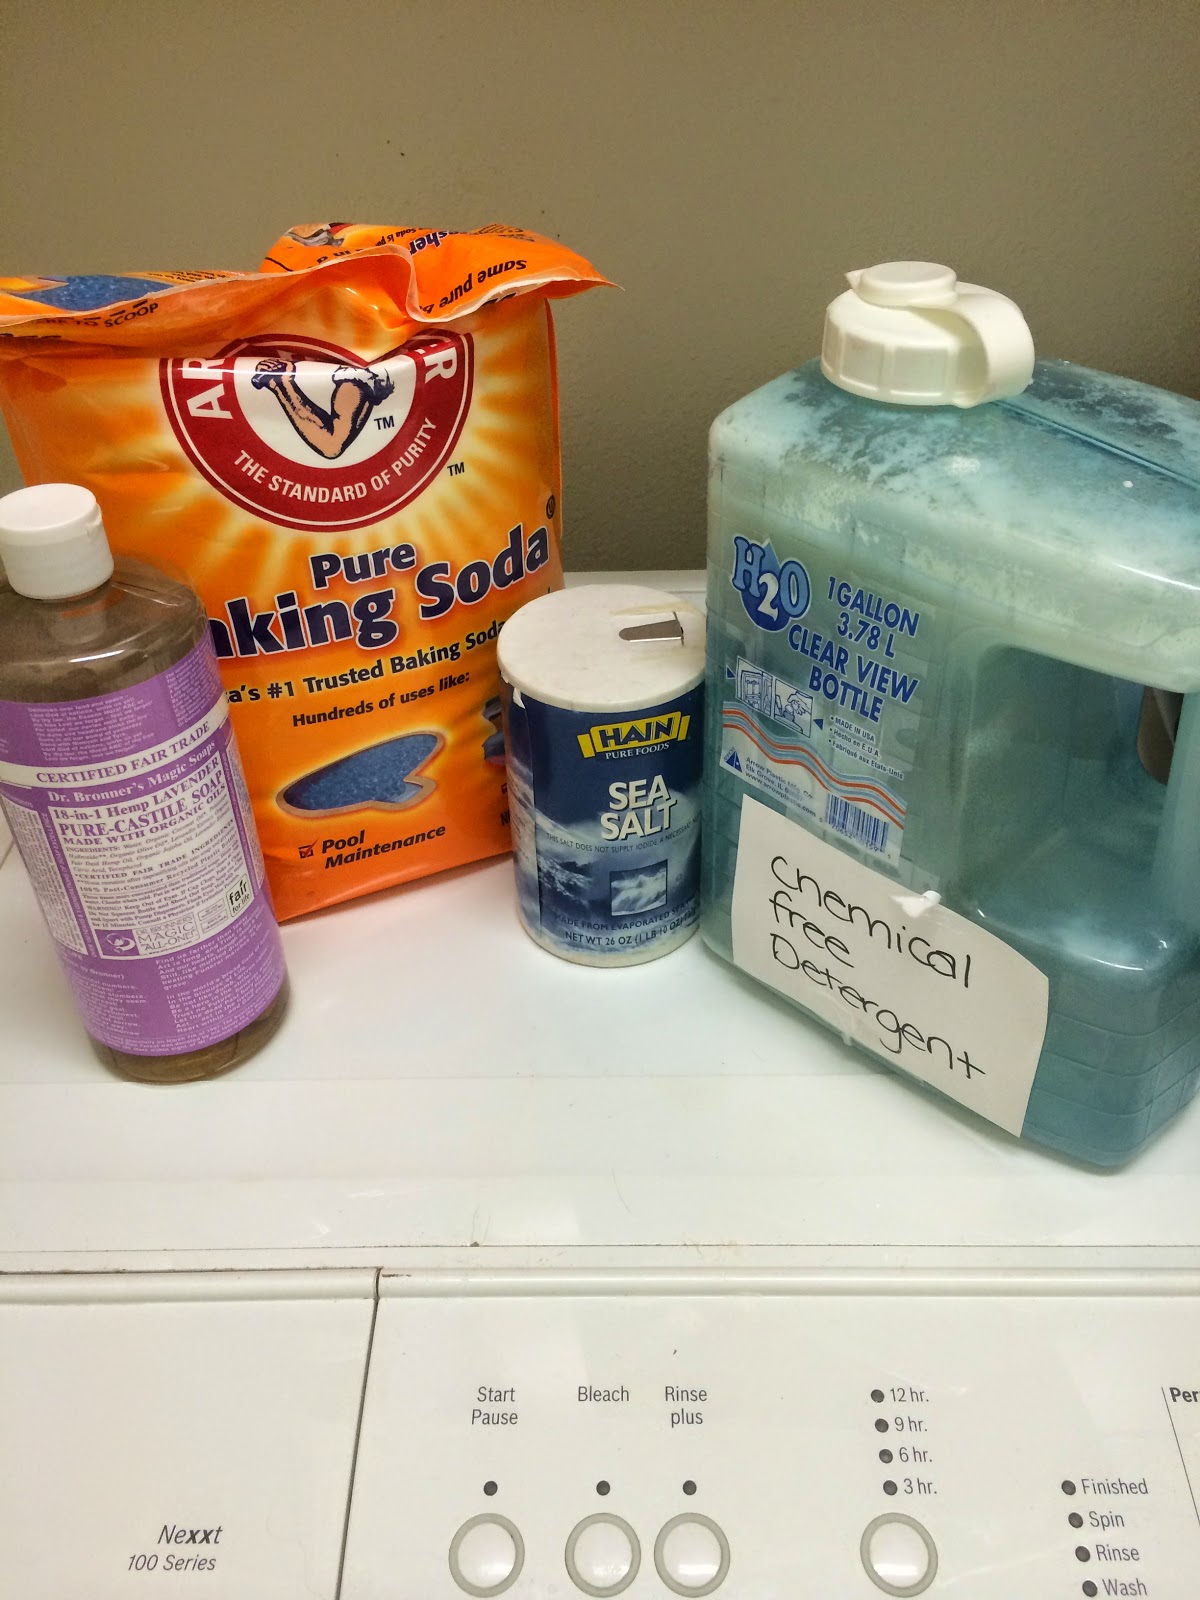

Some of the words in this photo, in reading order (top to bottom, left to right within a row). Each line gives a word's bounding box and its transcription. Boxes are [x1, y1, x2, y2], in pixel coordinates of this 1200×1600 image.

[477, 260, 528, 283] Same
[439, 277, 473, 309] pure
[104, 302, 159, 327] SCOOP
[182, 357, 233, 420] AR
[374, 416, 395, 431] TM
[233, 450, 264, 485] THE
[268, 475, 369, 504] STANDARD
[371, 472, 392, 491] OF
[392, 417, 438, 478] PURITY
[447, 462, 466, 477] TM
[310, 542, 417, 590] Pure
[415, 523, 550, 621] Soda
[837, 582, 920, 637] GALLON
[837, 611, 882, 651] 3.78
[885, 633, 896, 659] L
[267, 682, 294, 699] #1
[303, 660, 385, 695] Trusted
[390, 640, 461, 674] Baking
[788, 624, 850, 676] CLEAR
[857, 655, 920, 705] VIEW
[293, 700, 375, 728] Hundreds
[379, 694, 397, 711] of
[400, 686, 435, 706] uses
[438, 670, 471, 694] like:
[808, 665, 884, 723] BOTTLE
[598, 716, 676, 748] HAIN
[833, 729, 852, 743] Hecho
[835, 717, 853, 731] MADE
[854, 726, 861, 734] IN
[862, 731, 875, 743] USA
[36, 763, 128, 784] CERTIFIED
[130, 749, 168, 771] FAIR
[169, 720, 210, 755] TRADE
[605, 749, 634, 761] PURE
[635, 741, 671, 757] FOODS
[48, 791, 70, 803] Dr.
[73, 781, 145, 803] Bronner's
[147, 762, 187, 788] Magic
[188, 740, 216, 767] Soaps
[746, 757, 766, 771] Arrow
[858, 755, 870, 765] aux
[871, 760, 904, 780] Etats-Unis
[52, 807, 102, 821] 18-in-1
[106, 802, 150, 819] Hemp
[152, 756, 220, 806] LAVENDER
[608, 774, 671, 812] SEA
[59, 798, 189, 838] PURE-CASTILE
[191, 769, 223, 805] SOAP
[63, 837, 102, 846] MADE
[107, 829, 146, 844] WITH
[149, 804, 204, 834] ORGANIC
[206, 784, 226, 804] OILS
[600, 799, 677, 841] SALT
[321, 830, 366, 854] Pool
[324, 825, 447, 869] Maintenance
[546, 833, 559, 844] THIS
[560, 839, 574, 849] SALT
[575, 843, 593, 852] DOES
[611, 844, 634, 854] SUPPLY
[635, 839, 658, 851] IODIDE
[659, 835, 664, 844] A
[229, 880, 248, 907] fair
[138, 922, 195, 943] MAGIC
[581, 920, 608, 930] FROM
[611, 912, 670, 931] EVAPORATED
[565, 931, 584, 943] NET
[586, 937, 602, 946] WT
[605, 937, 615, 946] 26
[618, 935, 632, 945] OZ
[770, 933, 986, 1080] Detergent
[477, 1386, 516, 1402] Start
[577, 1386, 630, 1402] Bleach
[665, 1386, 707, 1402] Rinse
[889, 1388, 907, 1402] 12
[909, 1387, 929, 1402] hr.
[1169, 1387, 1200, 1403] Per
[471, 1409, 518, 1425] Pause
[671, 1408, 704, 1428] plus
[894, 1416, 904, 1432] 9
[907, 1416, 928, 1432] hr.
[899, 1446, 909, 1462] 6
[912, 1446, 933, 1462] hr.
[903, 1478, 914, 1495] 3
[917, 1477, 937, 1495] hr.
[1081, 1478, 1149, 1496] Finished
[1088, 1511, 1125, 1531] Spin
[157, 1524, 223, 1545] Nexxt
[127, 1554, 158, 1571] 100
[162, 1554, 217, 1571] Series
[1095, 1544, 1141, 1562] Rinse
[1102, 1578, 1148, 1597] Wash
